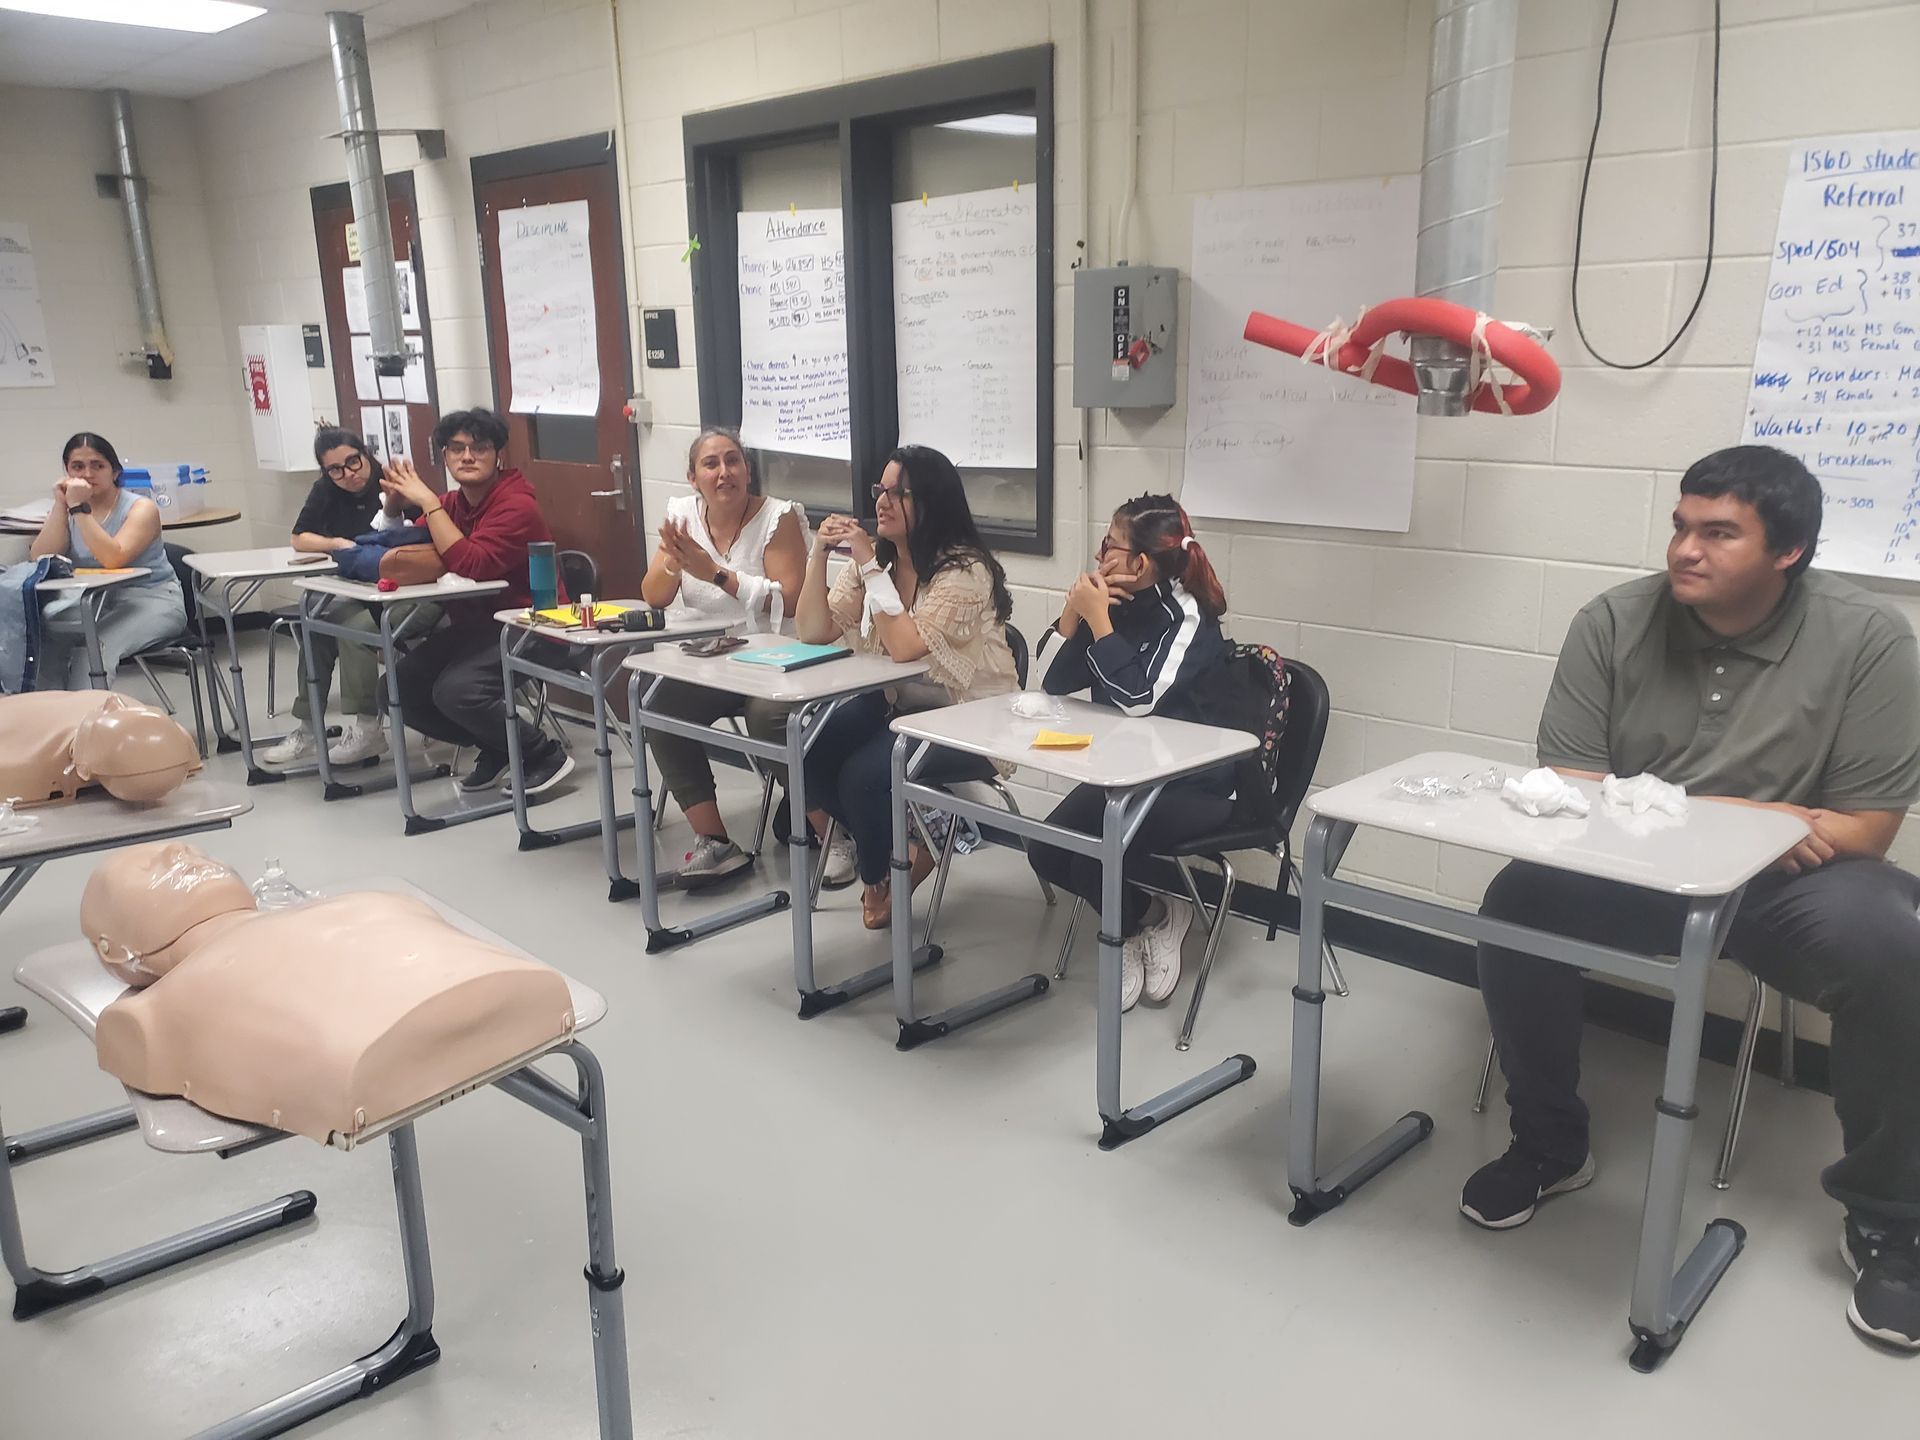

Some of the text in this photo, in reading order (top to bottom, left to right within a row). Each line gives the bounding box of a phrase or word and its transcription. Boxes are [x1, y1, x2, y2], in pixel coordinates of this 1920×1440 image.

[1803, 149, 1920, 173] 1560 stude
[1823, 183, 1904, 208] Referral
[766, 217, 826, 239] Attendance
[1776, 240, 1860, 265] Sped/504
[1117, 288, 1126, 306] ON
[1769, 275, 1843, 300] Gen Ed
[1117, 334, 1126, 360] OFF
[250, 363, 264, 373] FIRE
[1818, 451, 1893, 468] breakdown
